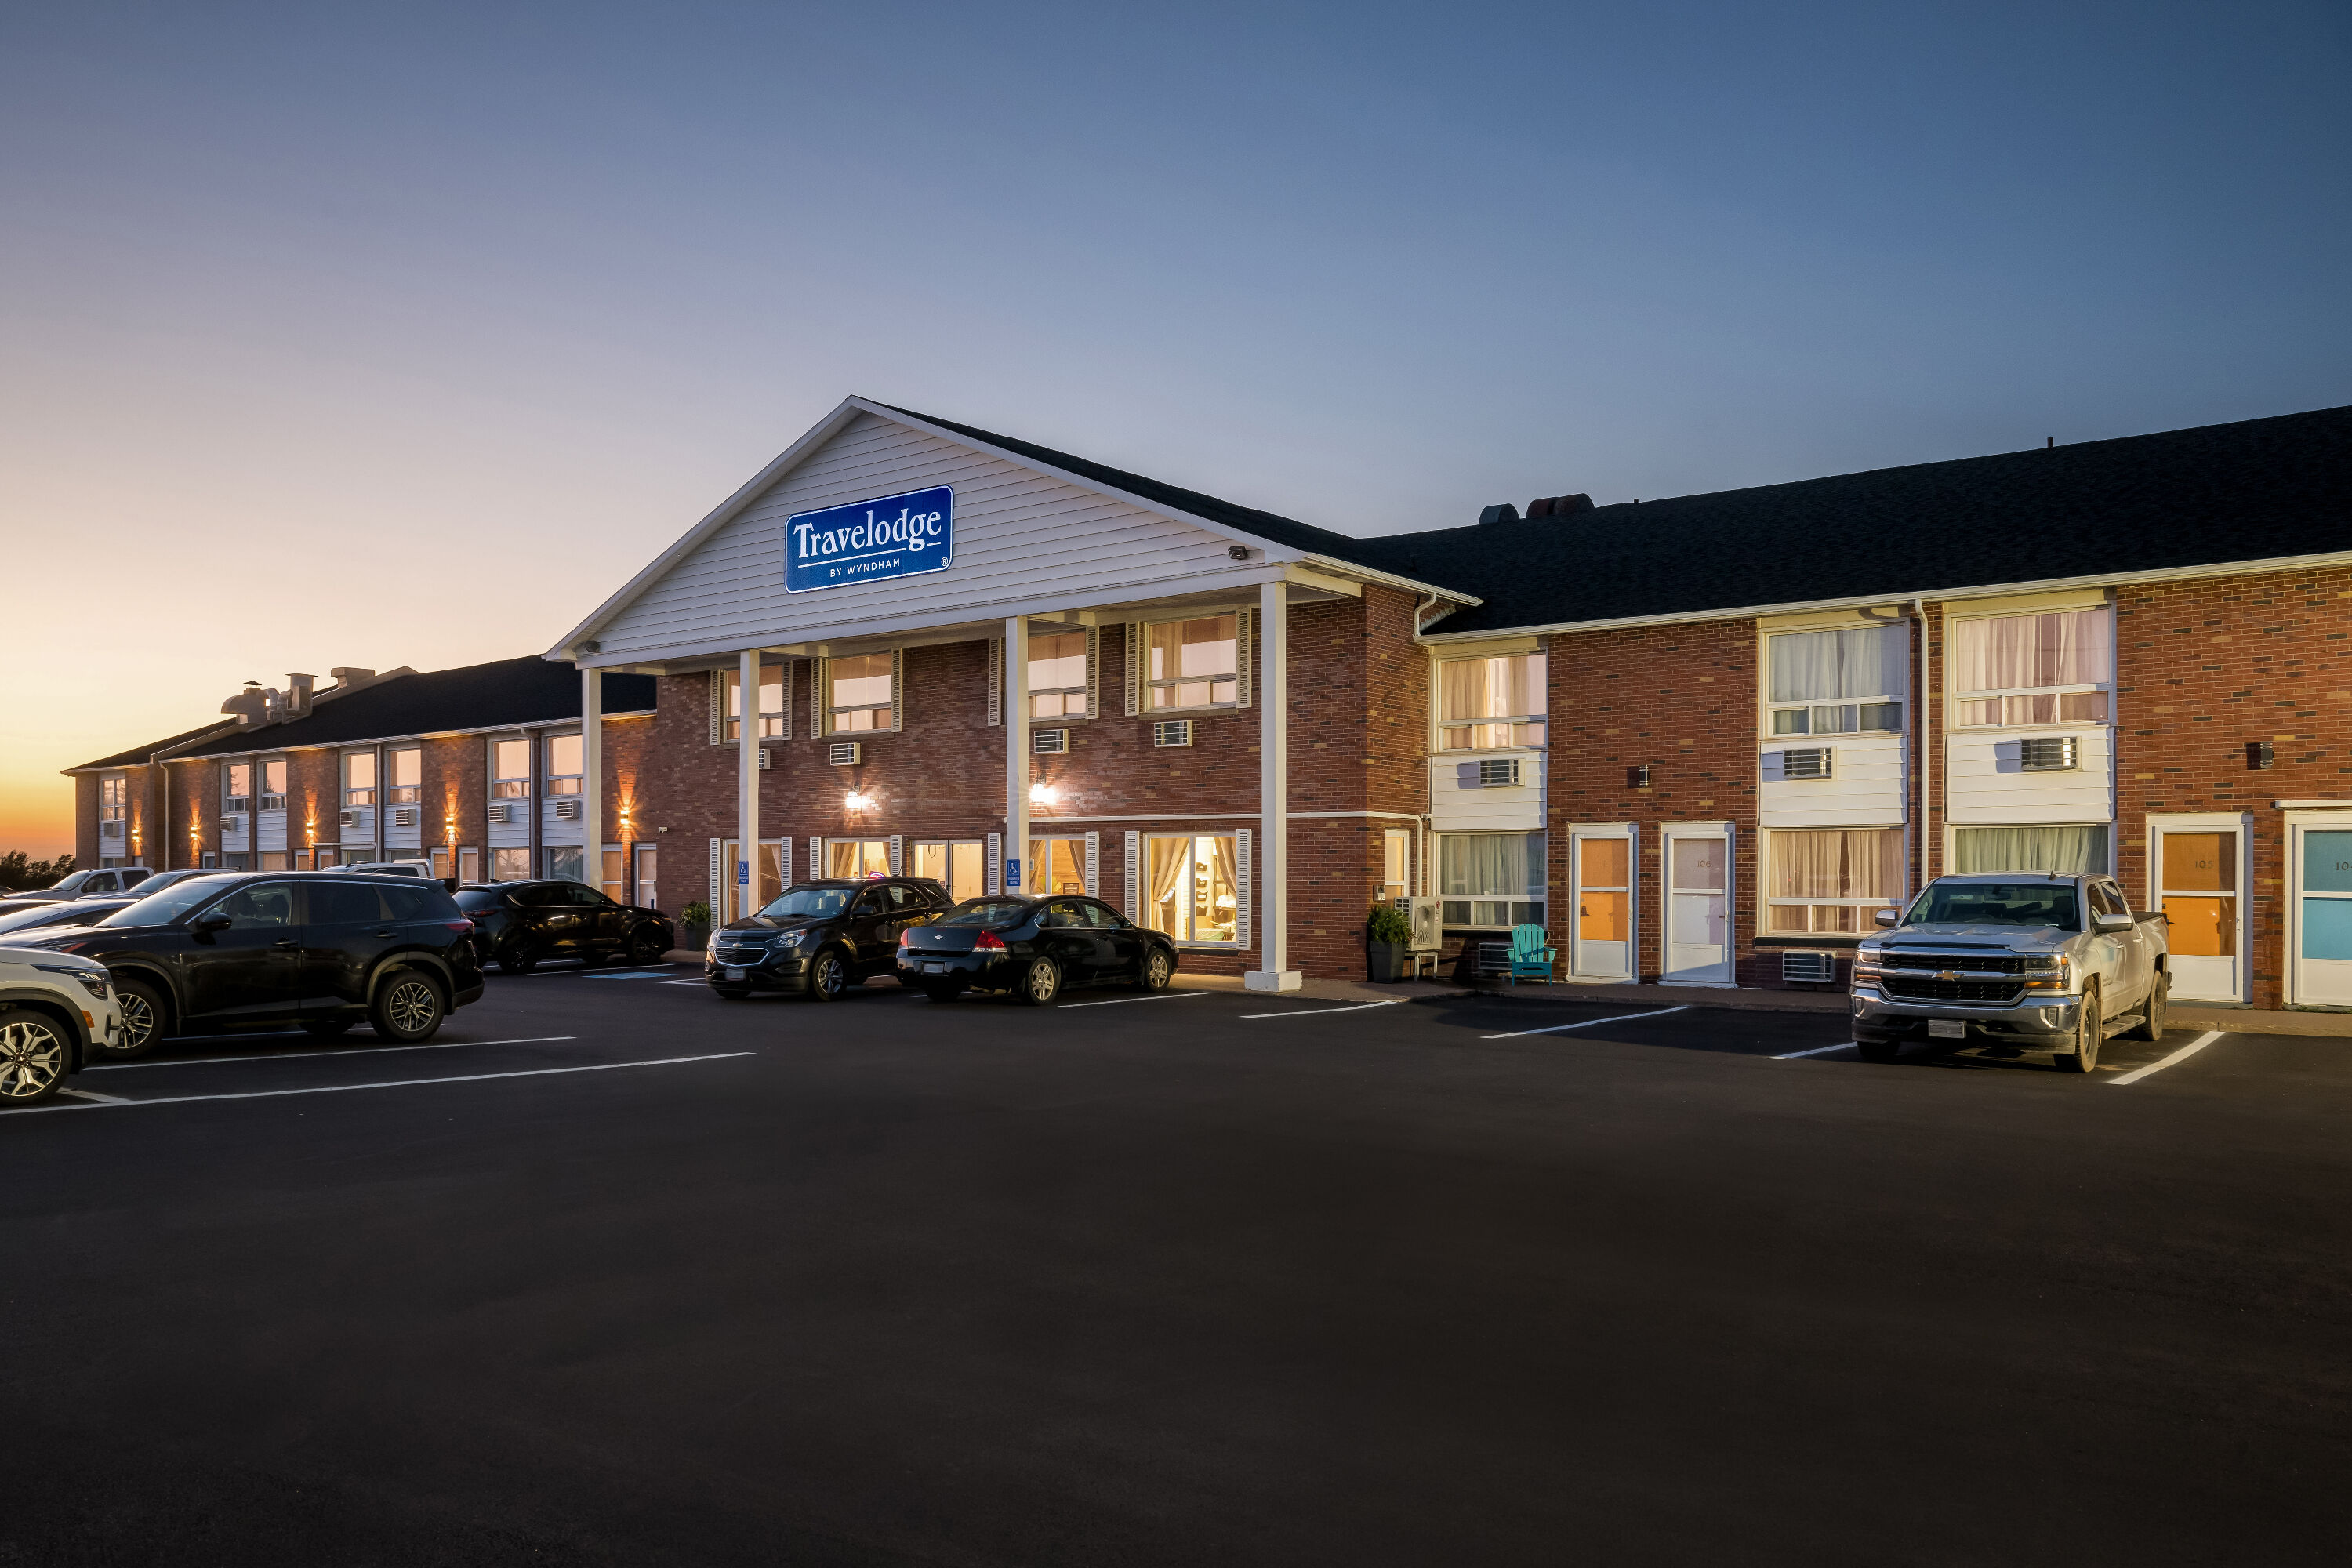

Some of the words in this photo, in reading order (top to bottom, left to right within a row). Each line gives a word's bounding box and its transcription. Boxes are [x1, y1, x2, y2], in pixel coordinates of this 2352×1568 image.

[793, 508, 942, 559] Travelodge
[829, 568, 842, 578] BY
[848, 558, 900, 574] WYNDHAM
[2195, 860, 2214, 869] 105
[2336, 862, 2352, 870] 10
